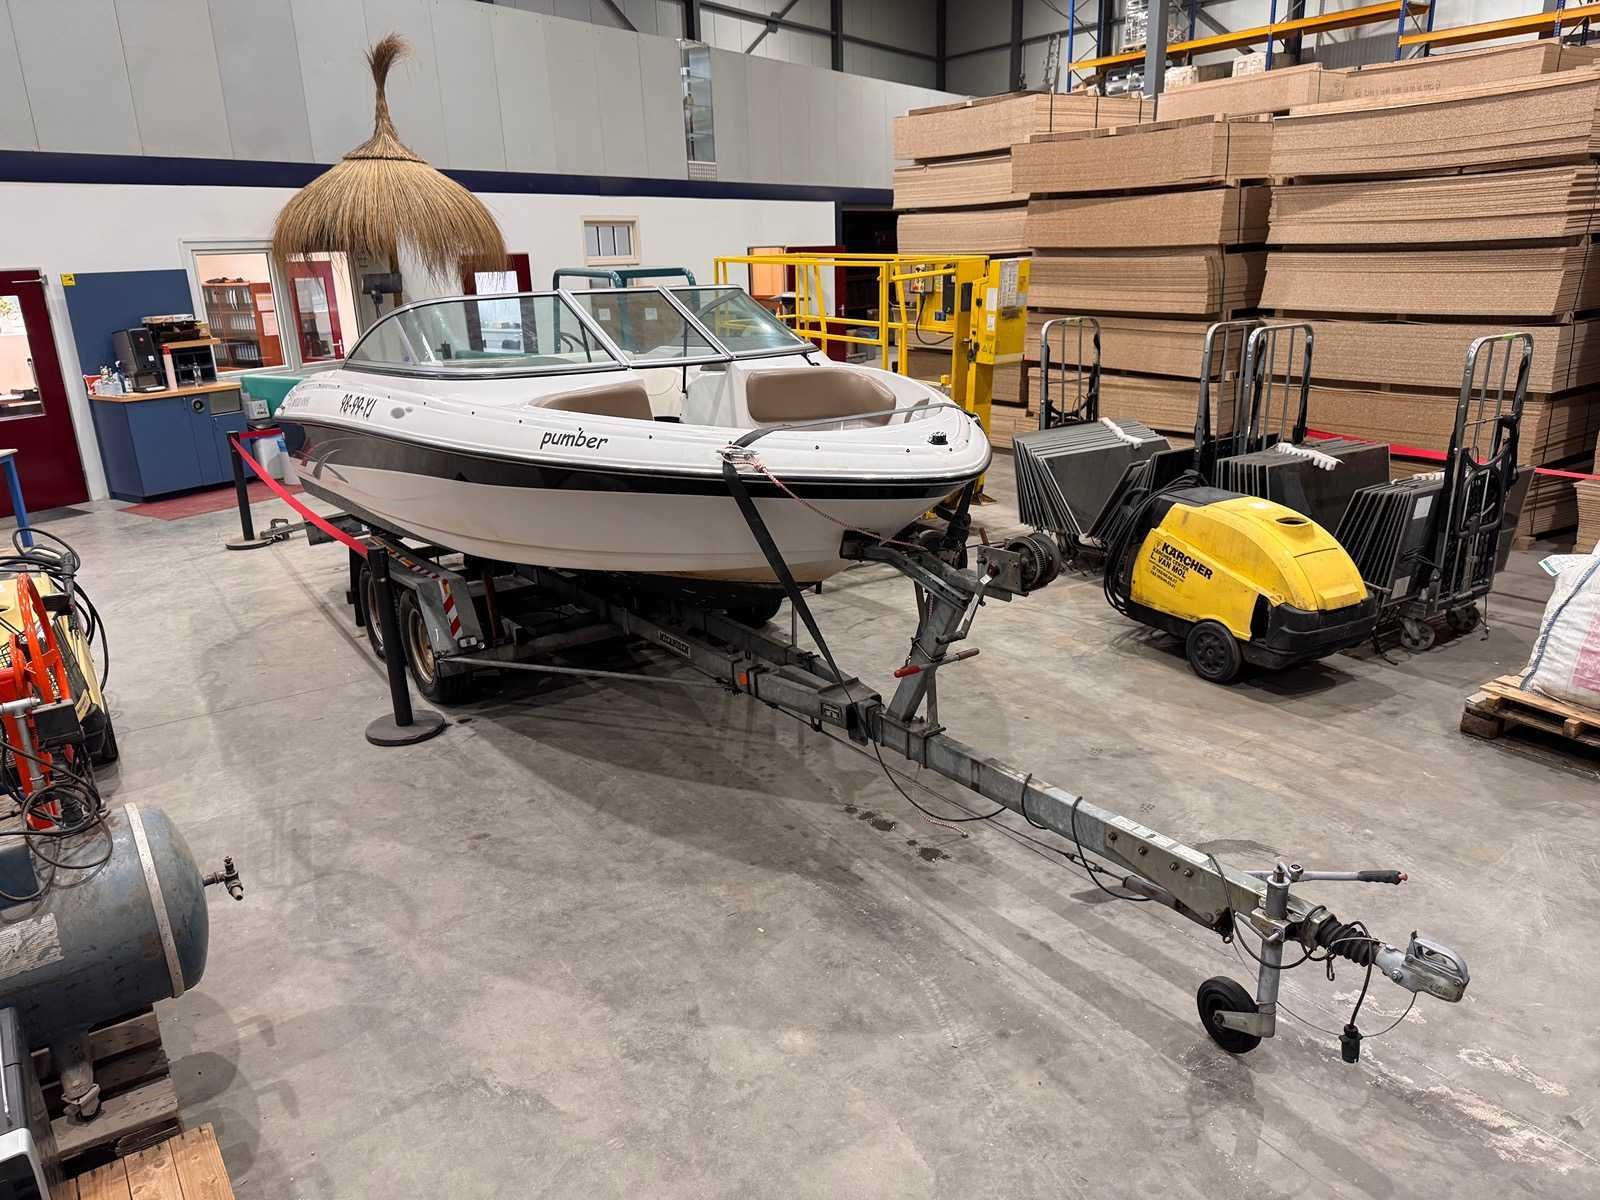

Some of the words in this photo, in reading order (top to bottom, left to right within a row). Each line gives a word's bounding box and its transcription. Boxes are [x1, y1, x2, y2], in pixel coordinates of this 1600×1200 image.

[539, 430, 609, 450] pumber
[1157, 555, 1171, 569] VAN
[1171, 564, 1186, 580] MOL
